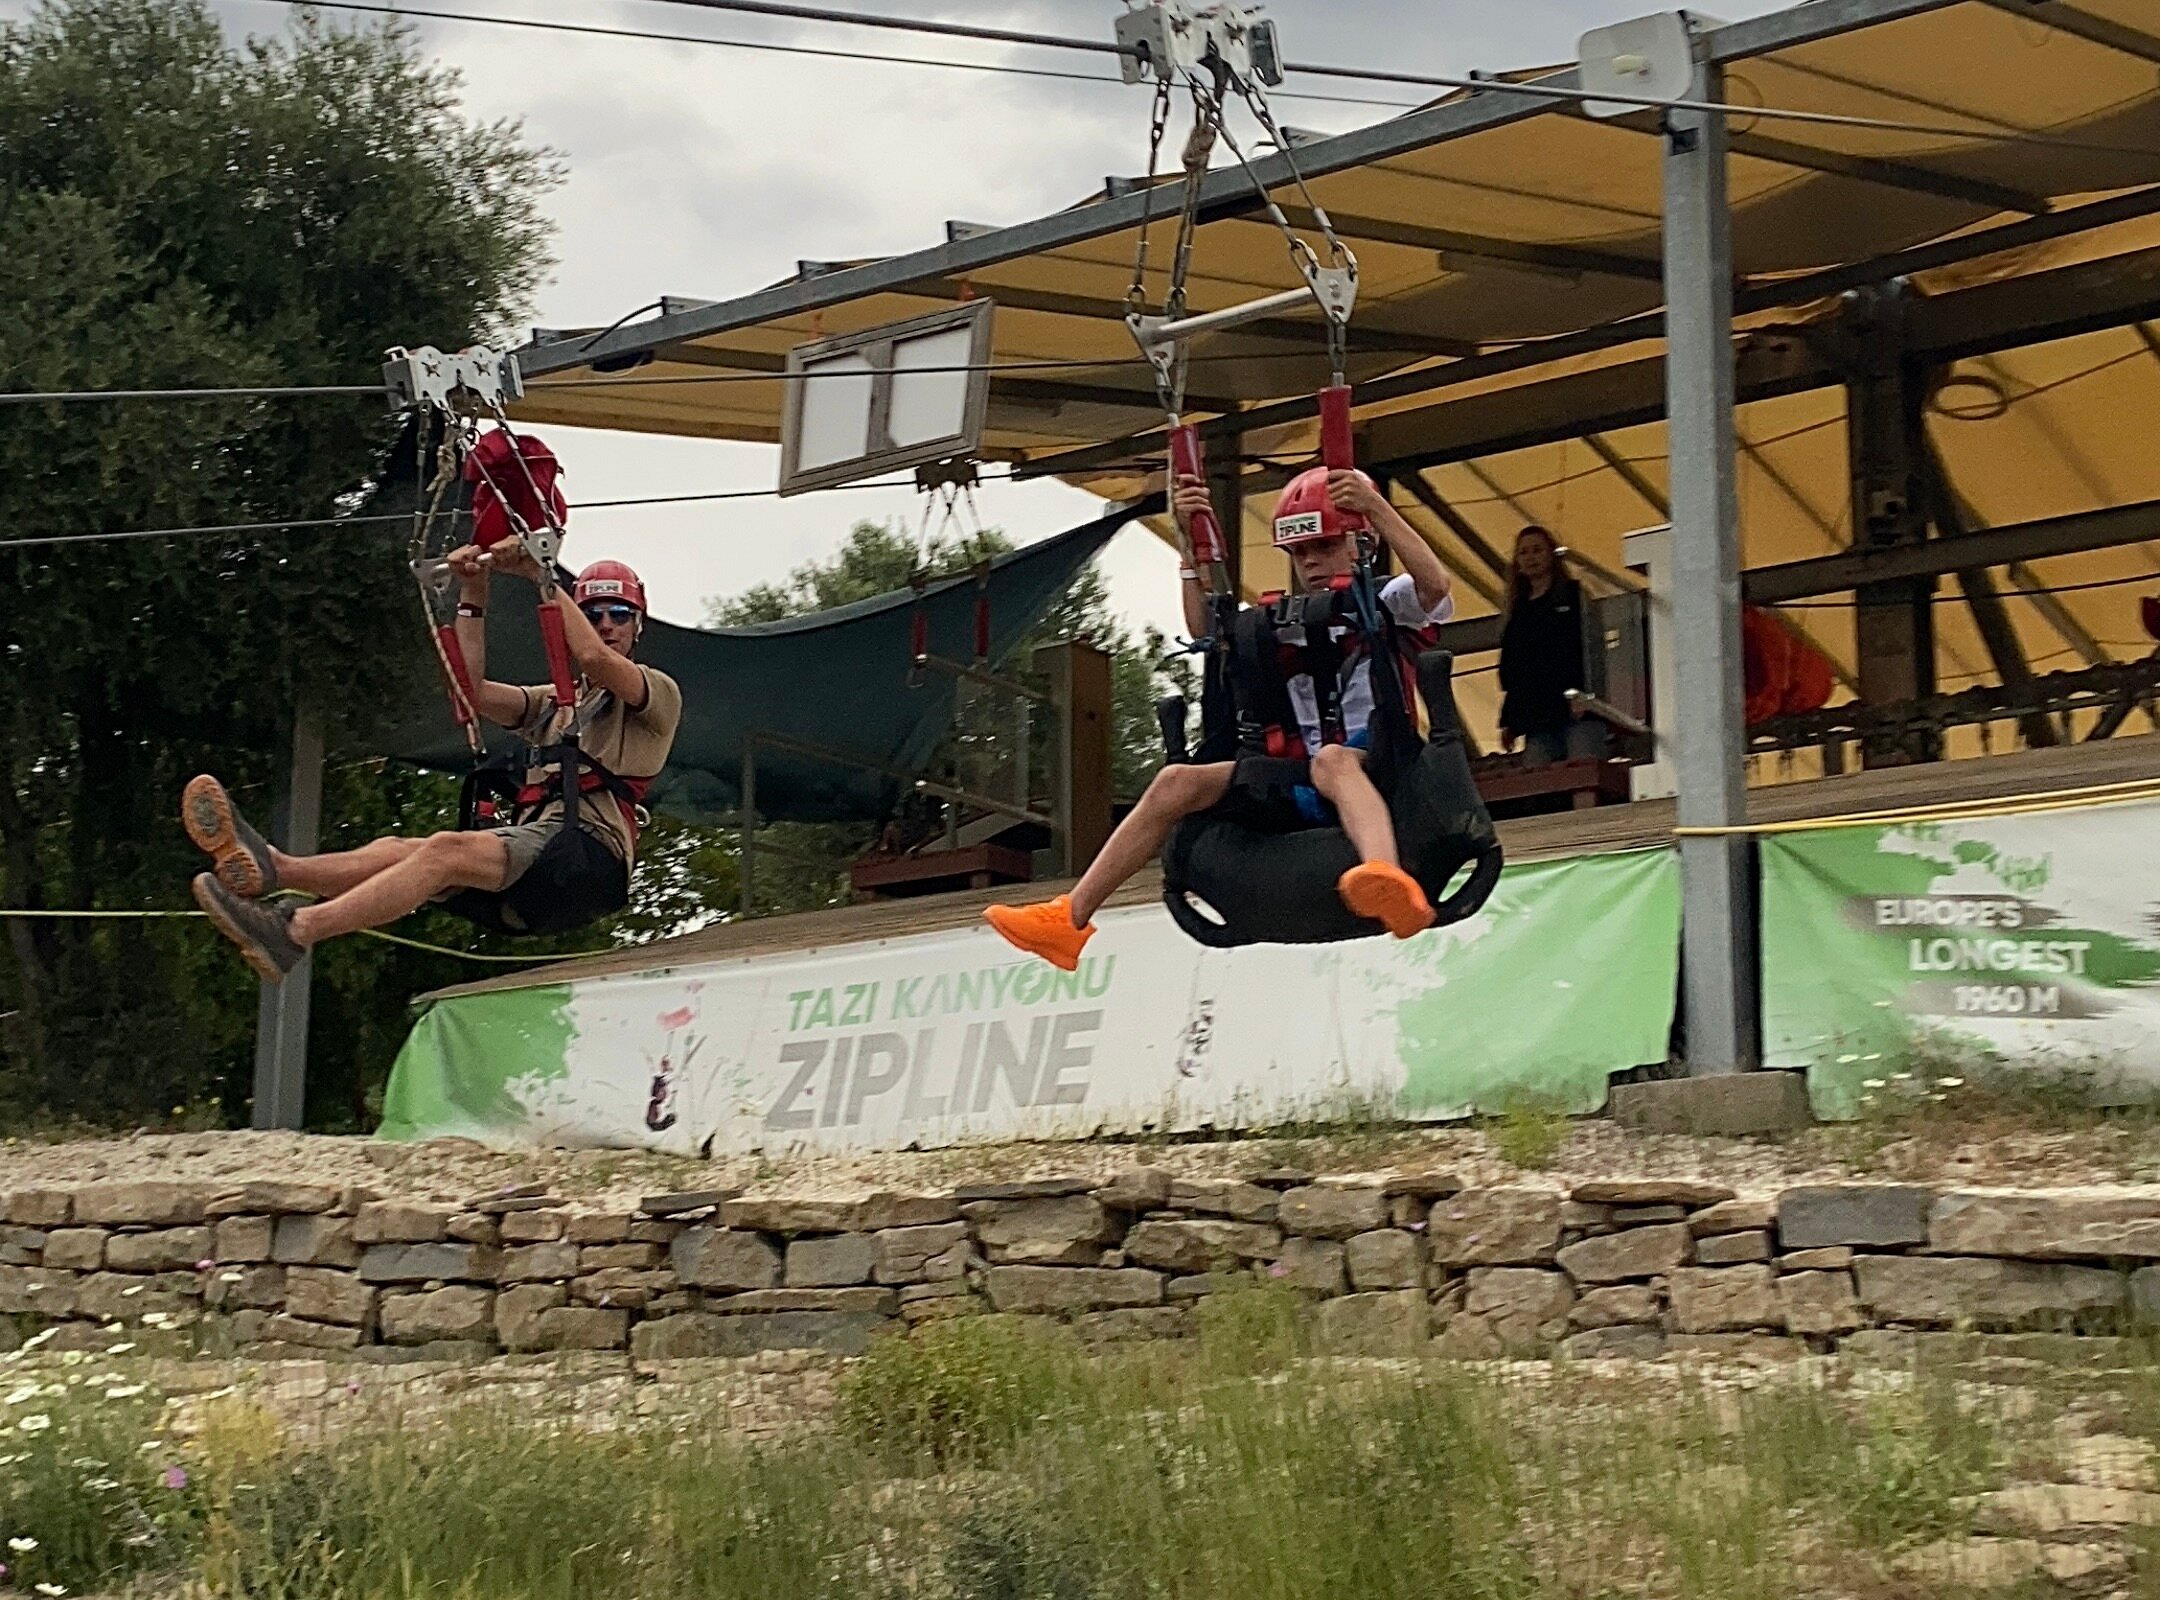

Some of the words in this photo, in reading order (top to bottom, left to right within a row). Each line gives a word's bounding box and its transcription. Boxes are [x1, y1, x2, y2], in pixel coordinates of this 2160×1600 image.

[1909, 938, 2091, 974] LONGEST
[789, 981, 881, 1031] TAZI
[892, 954, 1117, 1019] KANYONU
[1953, 985, 2026, 1013] 1960
[2030, 986, 2061, 1013] M
[765, 1009, 1105, 1132] ZIPLINE
